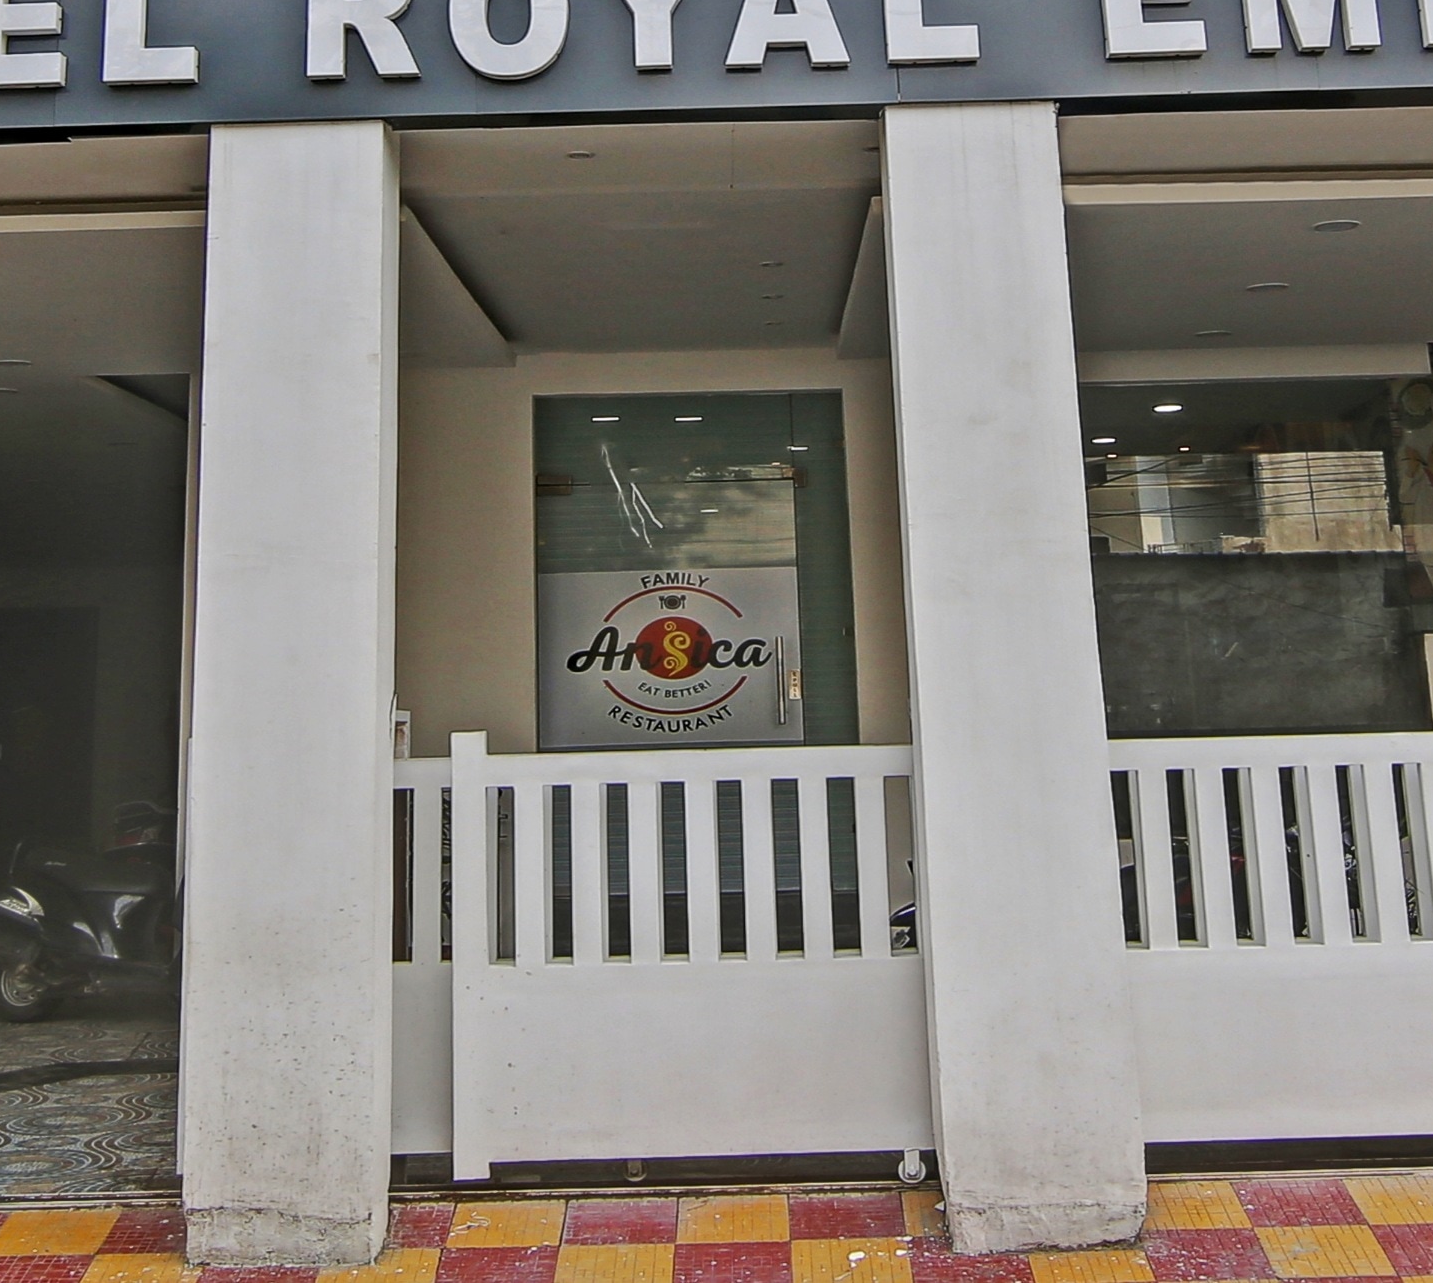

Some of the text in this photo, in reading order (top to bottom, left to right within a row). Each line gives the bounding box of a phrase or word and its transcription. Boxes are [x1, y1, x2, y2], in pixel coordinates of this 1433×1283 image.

[640, 572, 710, 589] FAMILY
[638, 679, 712, 698] EAT BETTER!
[608, 705, 734, 733] RESTAURANT
